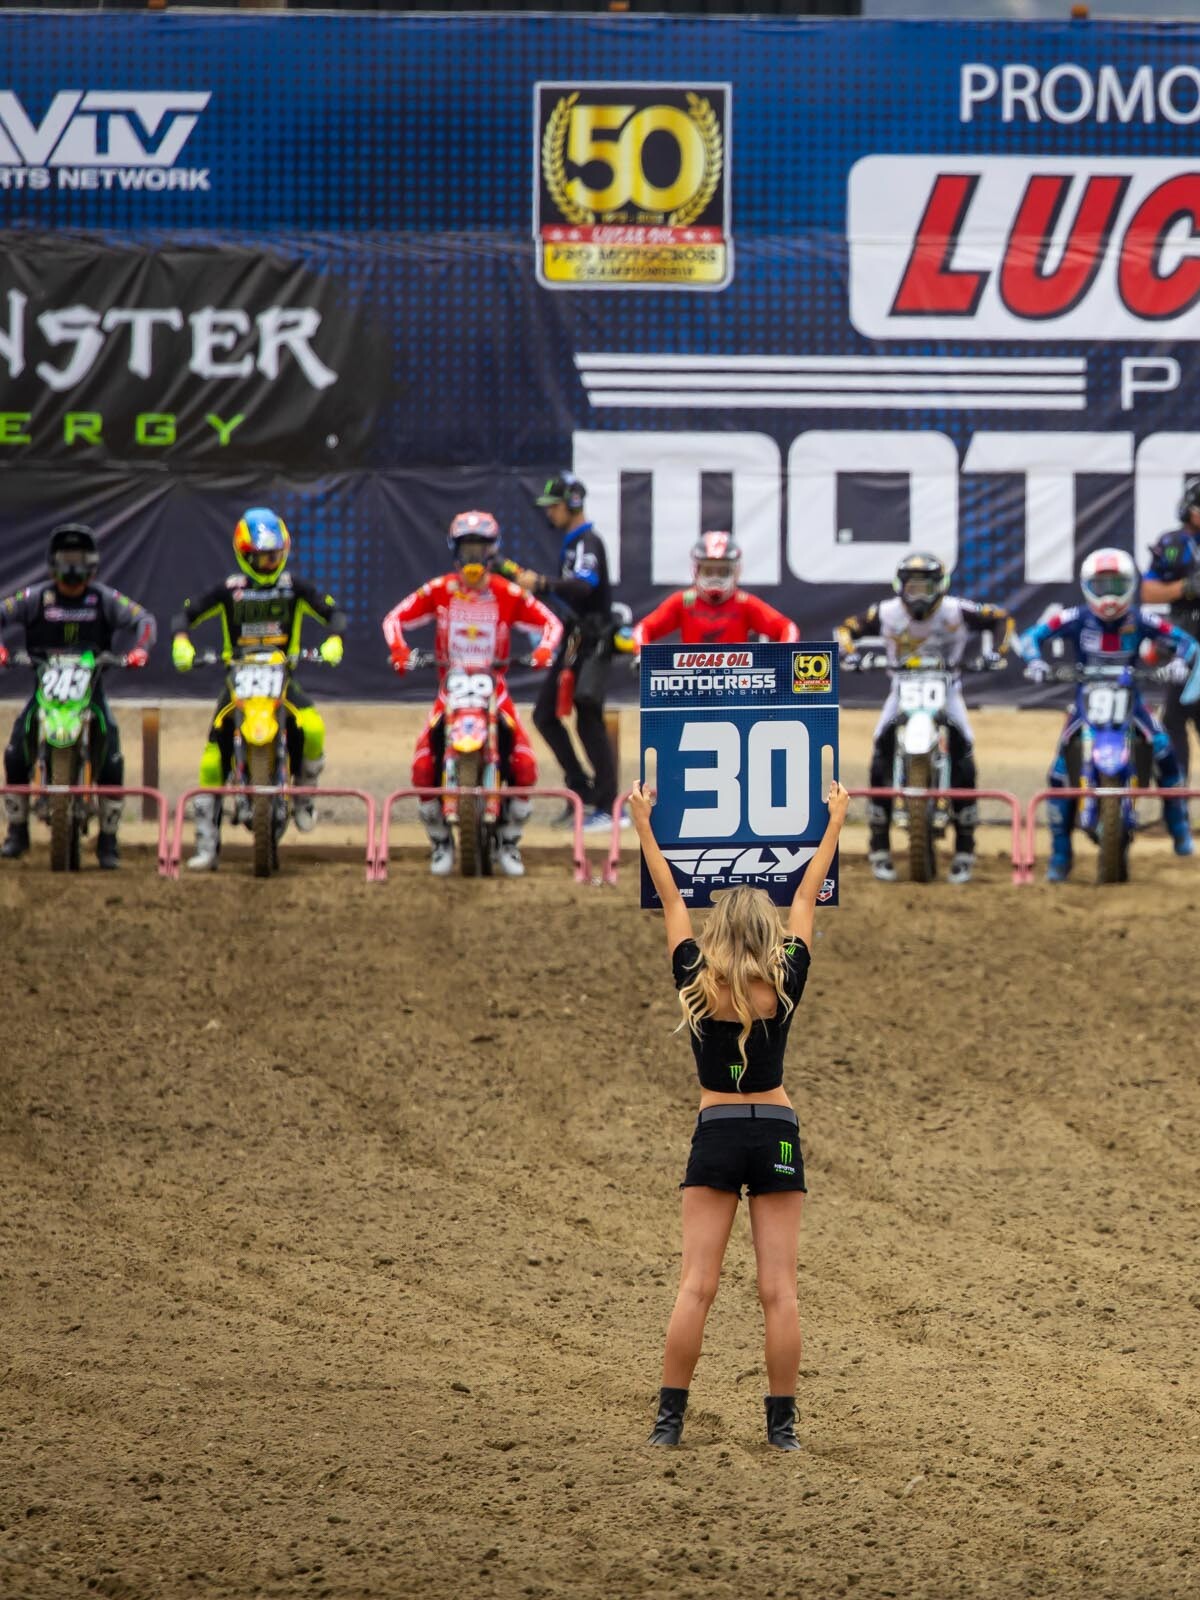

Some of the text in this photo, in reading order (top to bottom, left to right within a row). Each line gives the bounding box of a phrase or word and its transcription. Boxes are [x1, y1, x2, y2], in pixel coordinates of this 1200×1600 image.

[565, 104, 706, 214] 50
[58, 168, 211, 191] NETWORK
[677, 653, 750, 668] LUCAS OIL
[799, 655, 828, 678] 50
[650, 675, 776, 690] MOTOCROSS
[650, 689, 777, 697] CHAMPIONSHIP
[1087, 688, 1129, 725] 91
[678, 720, 811, 838] 30
[661, 847, 818, 875] FLY
[692, 875, 788, 884] RACING
